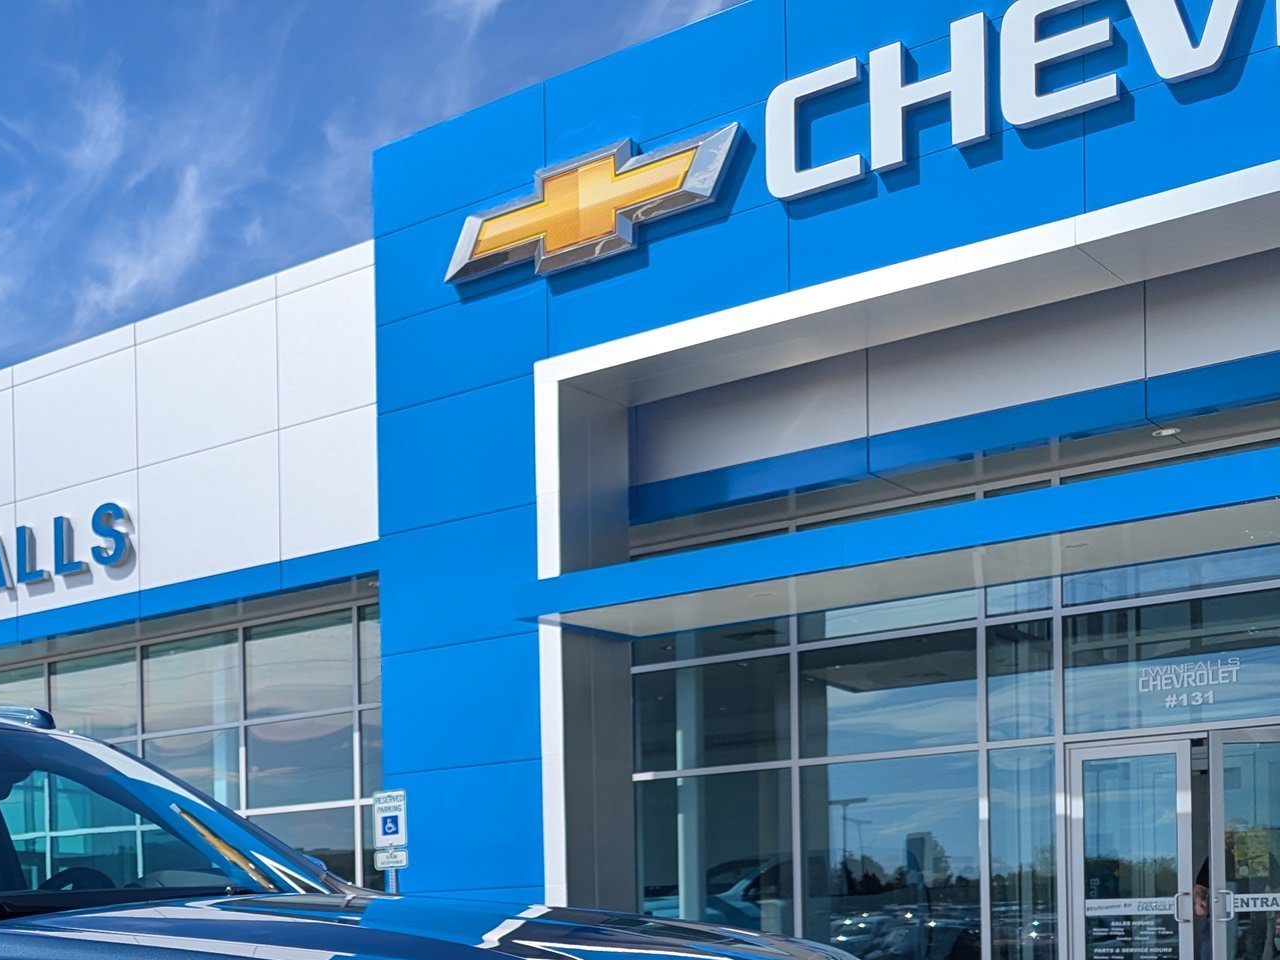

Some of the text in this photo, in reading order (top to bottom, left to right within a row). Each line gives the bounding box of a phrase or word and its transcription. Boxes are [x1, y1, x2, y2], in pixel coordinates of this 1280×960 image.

[765, 0, 1280, 200] CHEV
[1138, 666, 1240, 692] CHEVROLET
[1164, 690, 1214, 708] #131
[376, 804, 402, 814] PARKING
